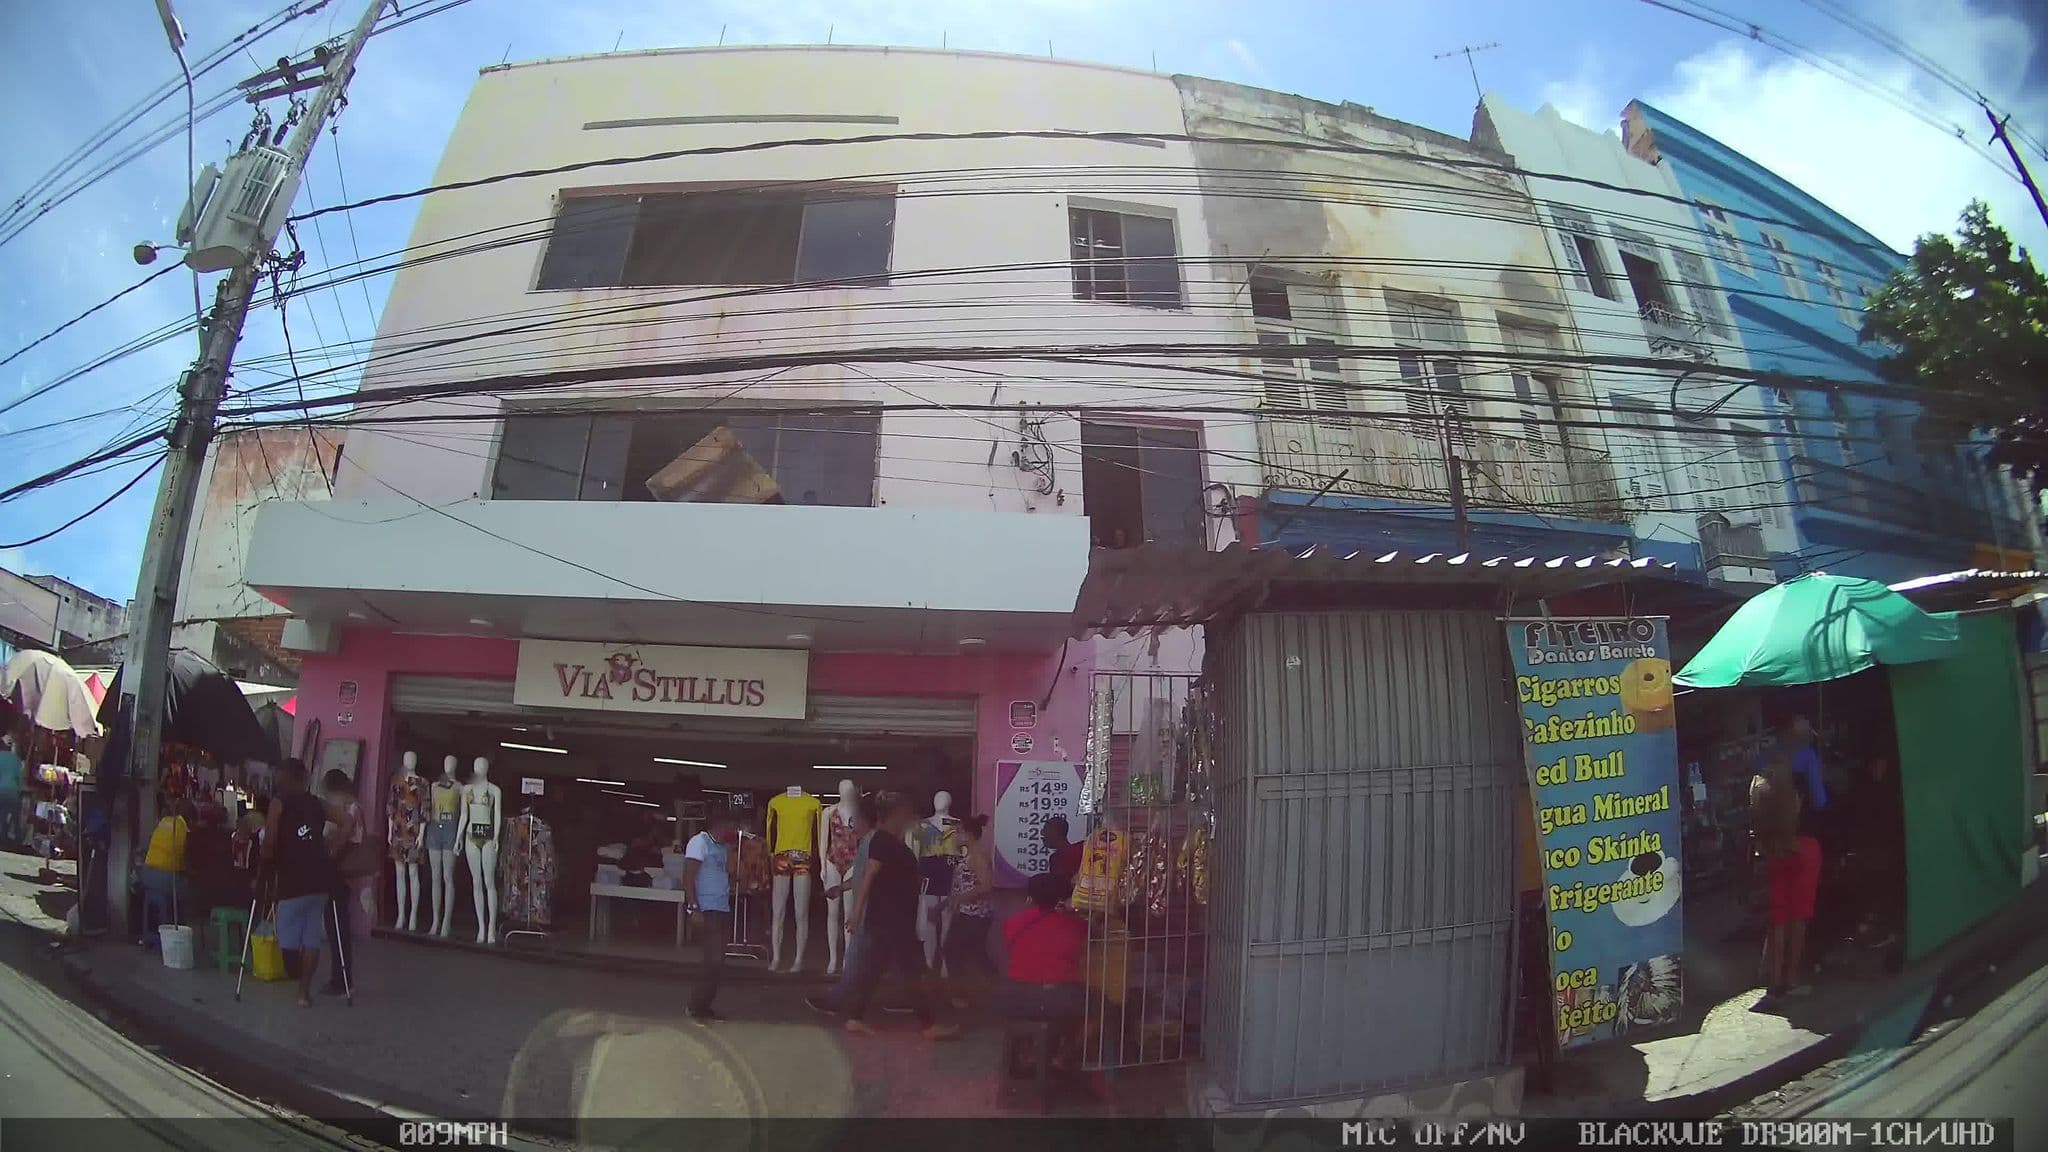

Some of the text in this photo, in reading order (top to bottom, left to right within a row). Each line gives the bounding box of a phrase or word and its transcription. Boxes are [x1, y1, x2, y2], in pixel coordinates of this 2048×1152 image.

[1525, 620, 1655, 648] FITEIRO
[1528, 643, 1656, 665] Dantas Barreto
[632, 668, 765, 706] STILLUS
[1517, 674, 1621, 707] Cigarros
[1575, 750, 1625, 783] Bull
[1594, 785, 1669, 822] Mineral
[1588, 830, 1662, 864] Skinka
[1558, 1000, 1617, 1031] feito
